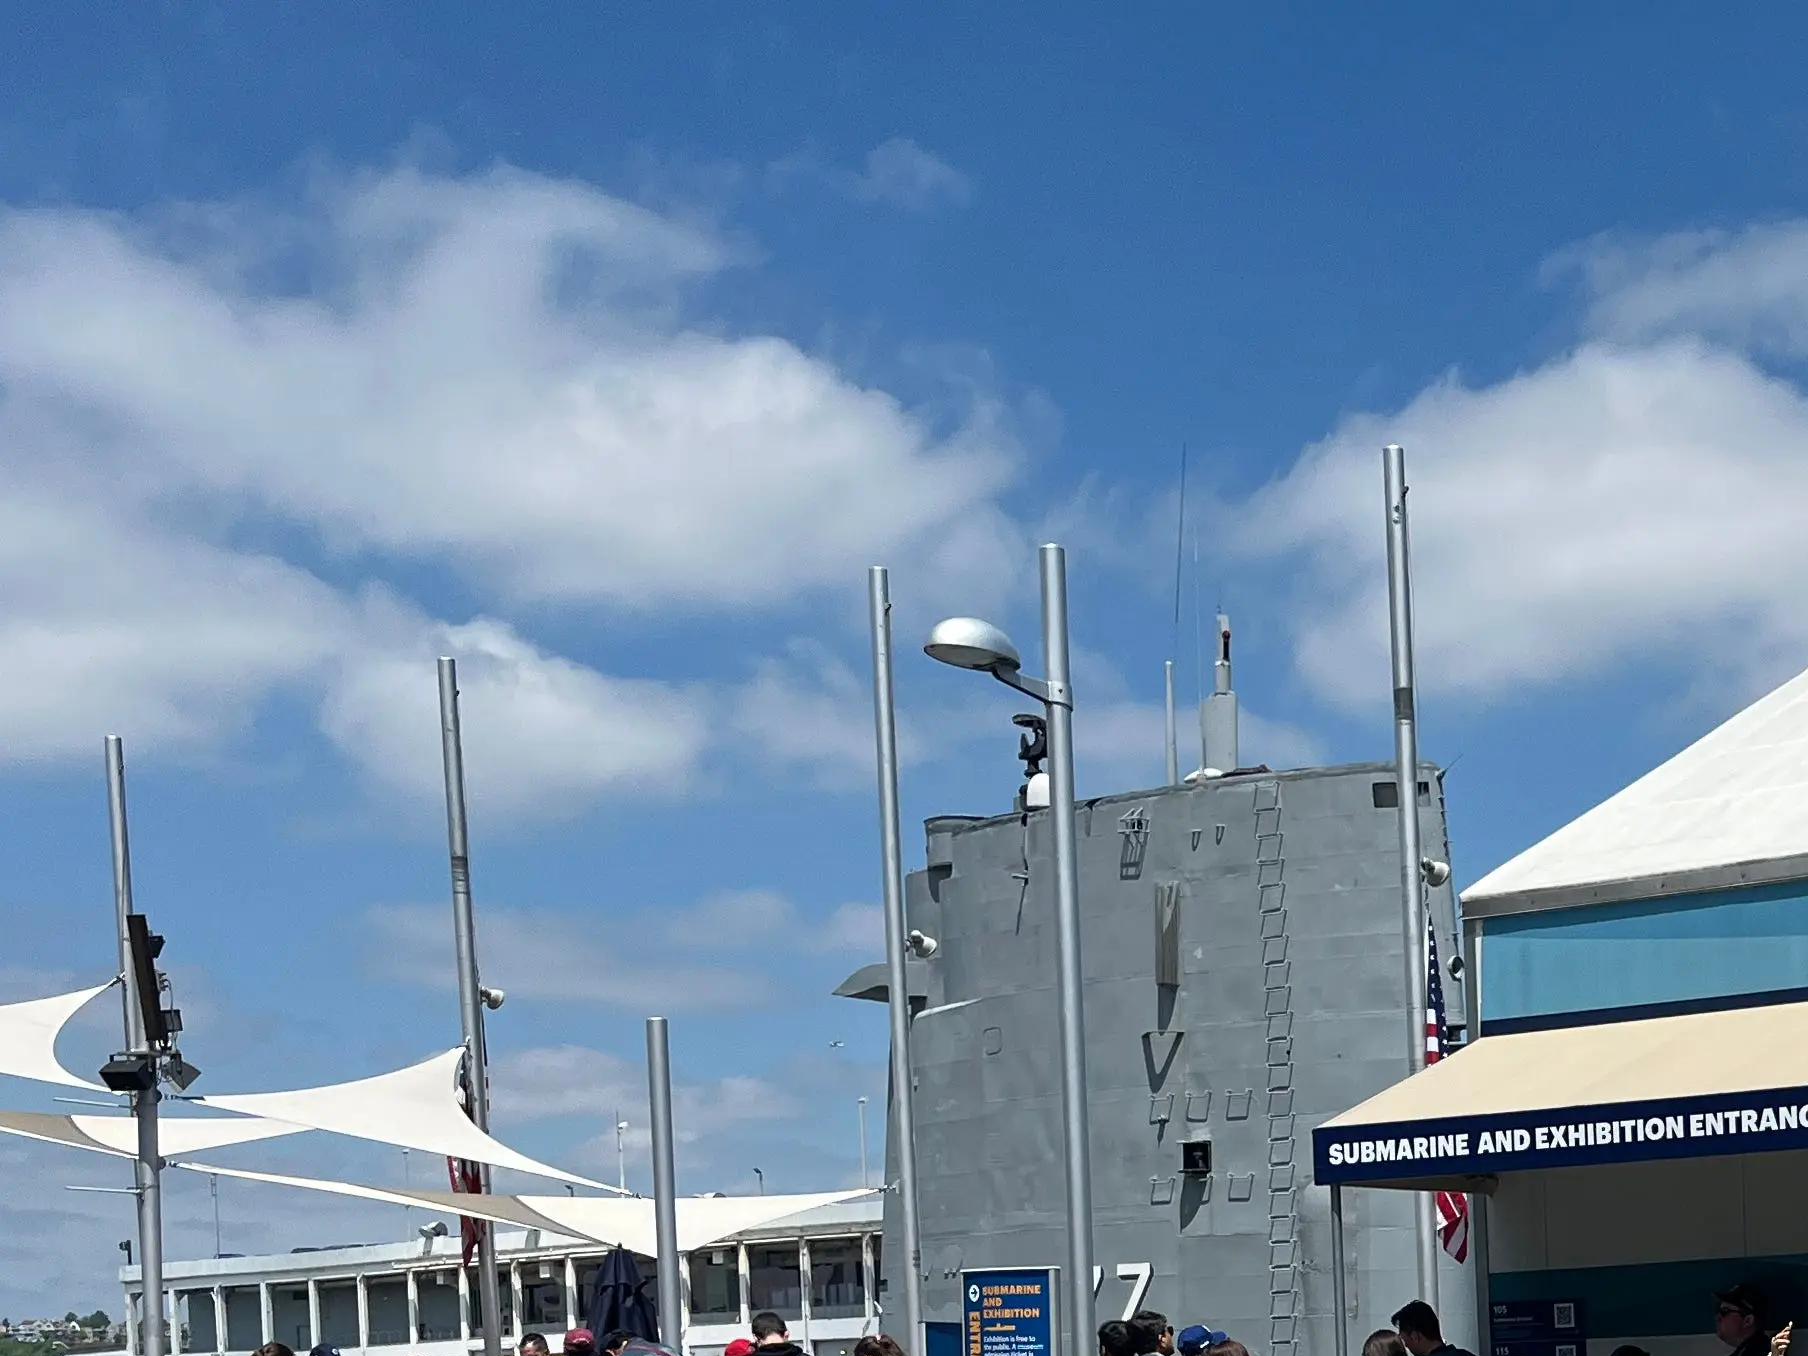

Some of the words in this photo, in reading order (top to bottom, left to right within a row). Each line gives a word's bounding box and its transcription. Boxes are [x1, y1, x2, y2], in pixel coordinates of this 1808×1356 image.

[1328, 1133, 1470, 1166] SUBMARINE
[1477, 1127, 1532, 1155] AND
[1535, 1115, 1685, 1151] EXHIBITION
[982, 1285, 1041, 1295] SUBMARINE
[983, 1298, 1002, 1307] AND
[983, 1308, 1040, 1318] EXHIBITION
